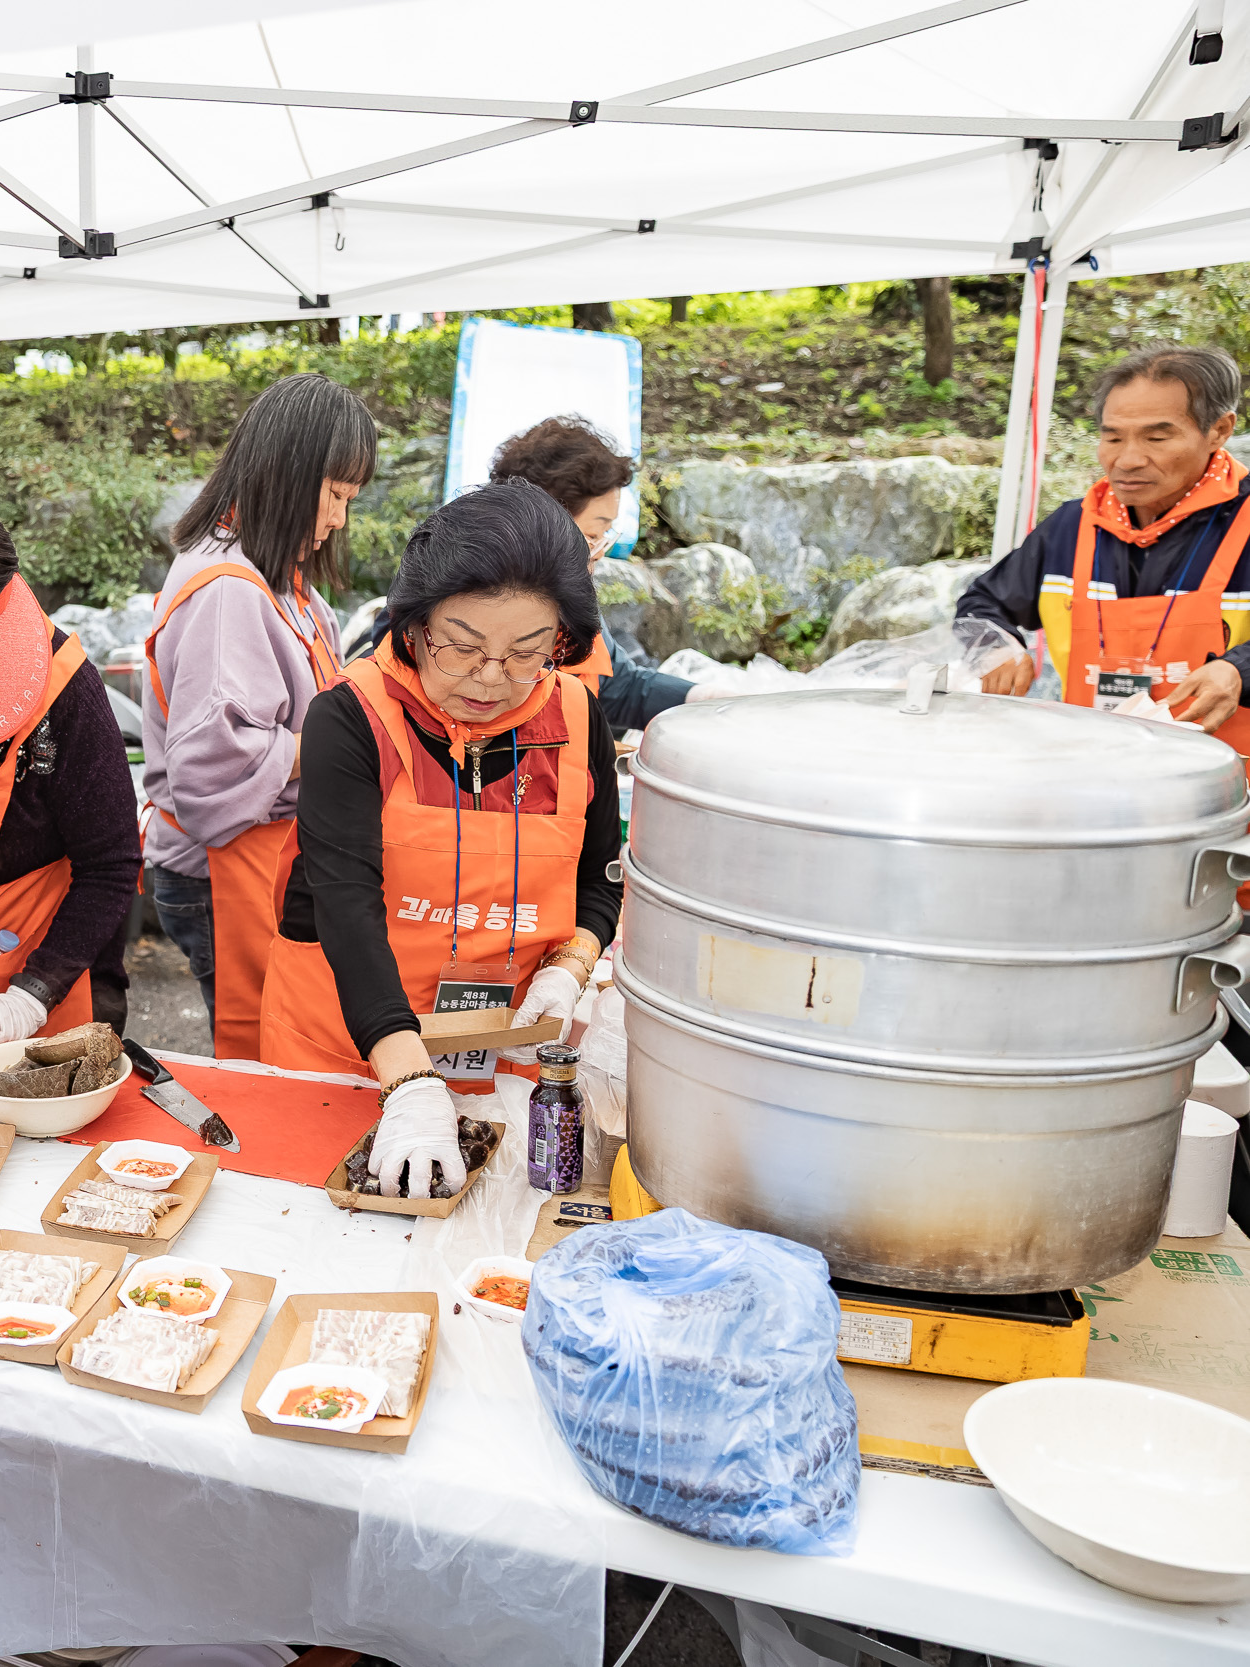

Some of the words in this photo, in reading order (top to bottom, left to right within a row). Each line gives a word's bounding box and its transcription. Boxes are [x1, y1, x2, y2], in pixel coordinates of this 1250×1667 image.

[396, 895, 480, 930] 감마을
[484, 902, 539, 933] 능동
[462, 990, 489, 1001] 제8회
